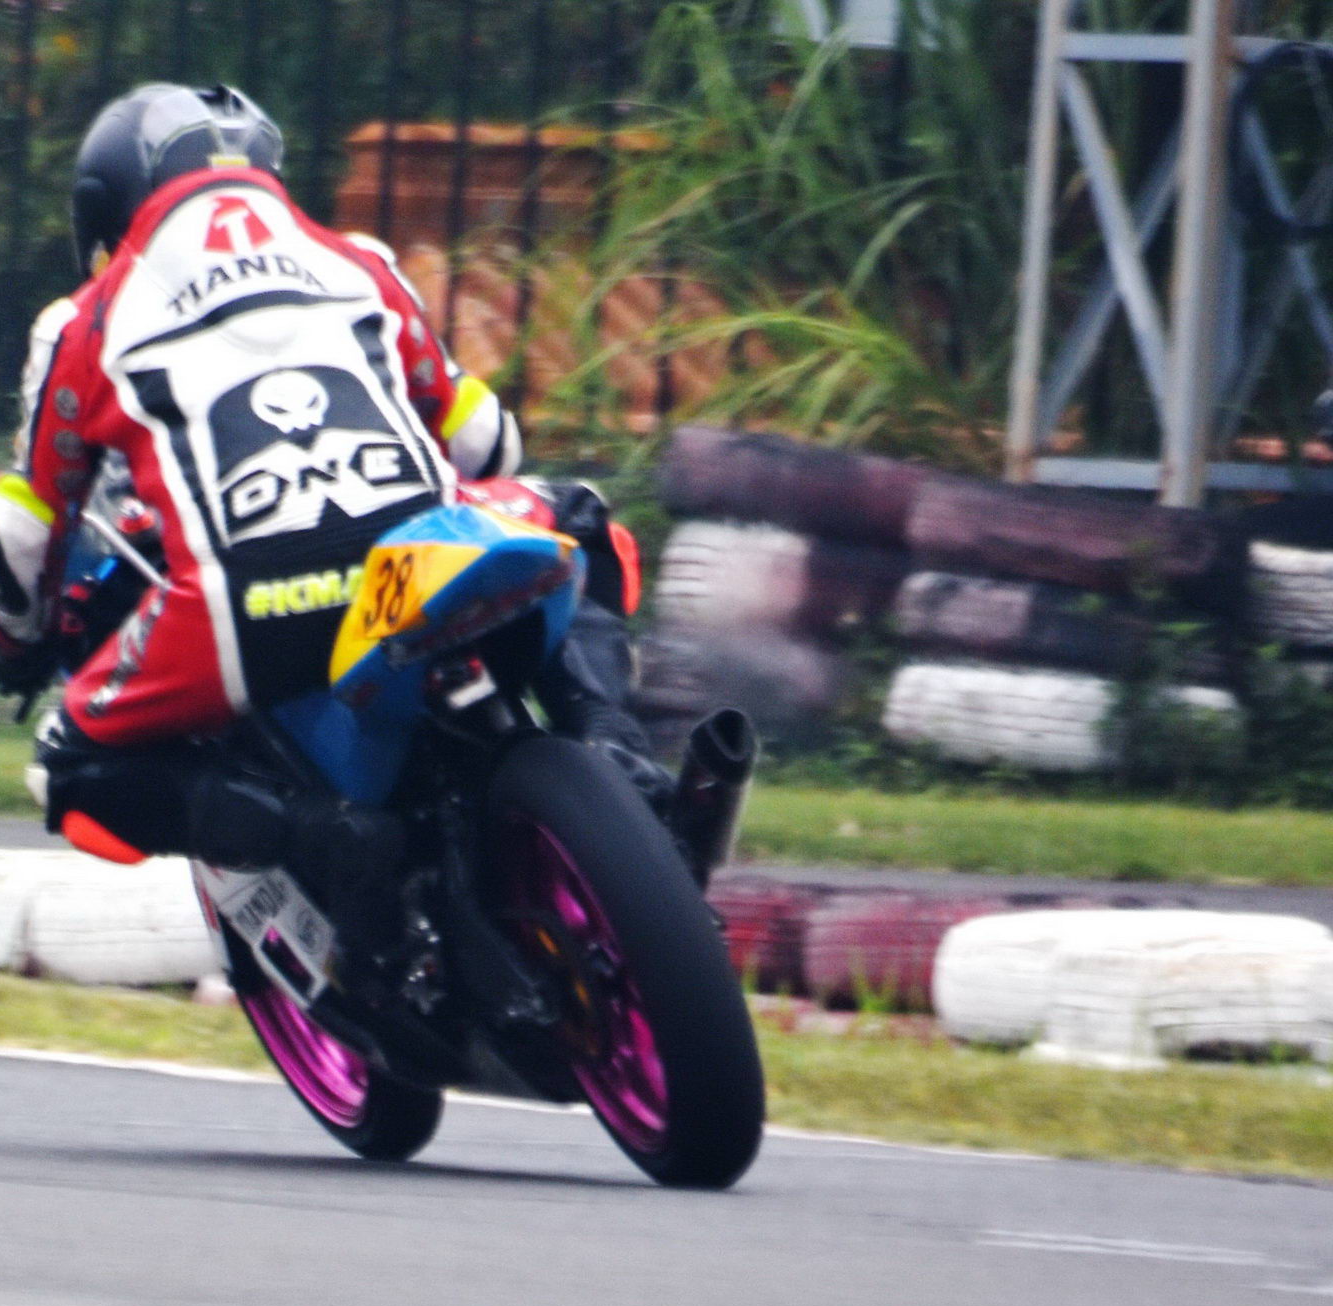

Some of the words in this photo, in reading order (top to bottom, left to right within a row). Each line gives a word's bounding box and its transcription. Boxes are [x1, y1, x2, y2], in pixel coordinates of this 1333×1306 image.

[167, 254, 329, 315] TIANDA
[222, 442, 426, 533] ONE
[363, 551, 414, 629] 38
